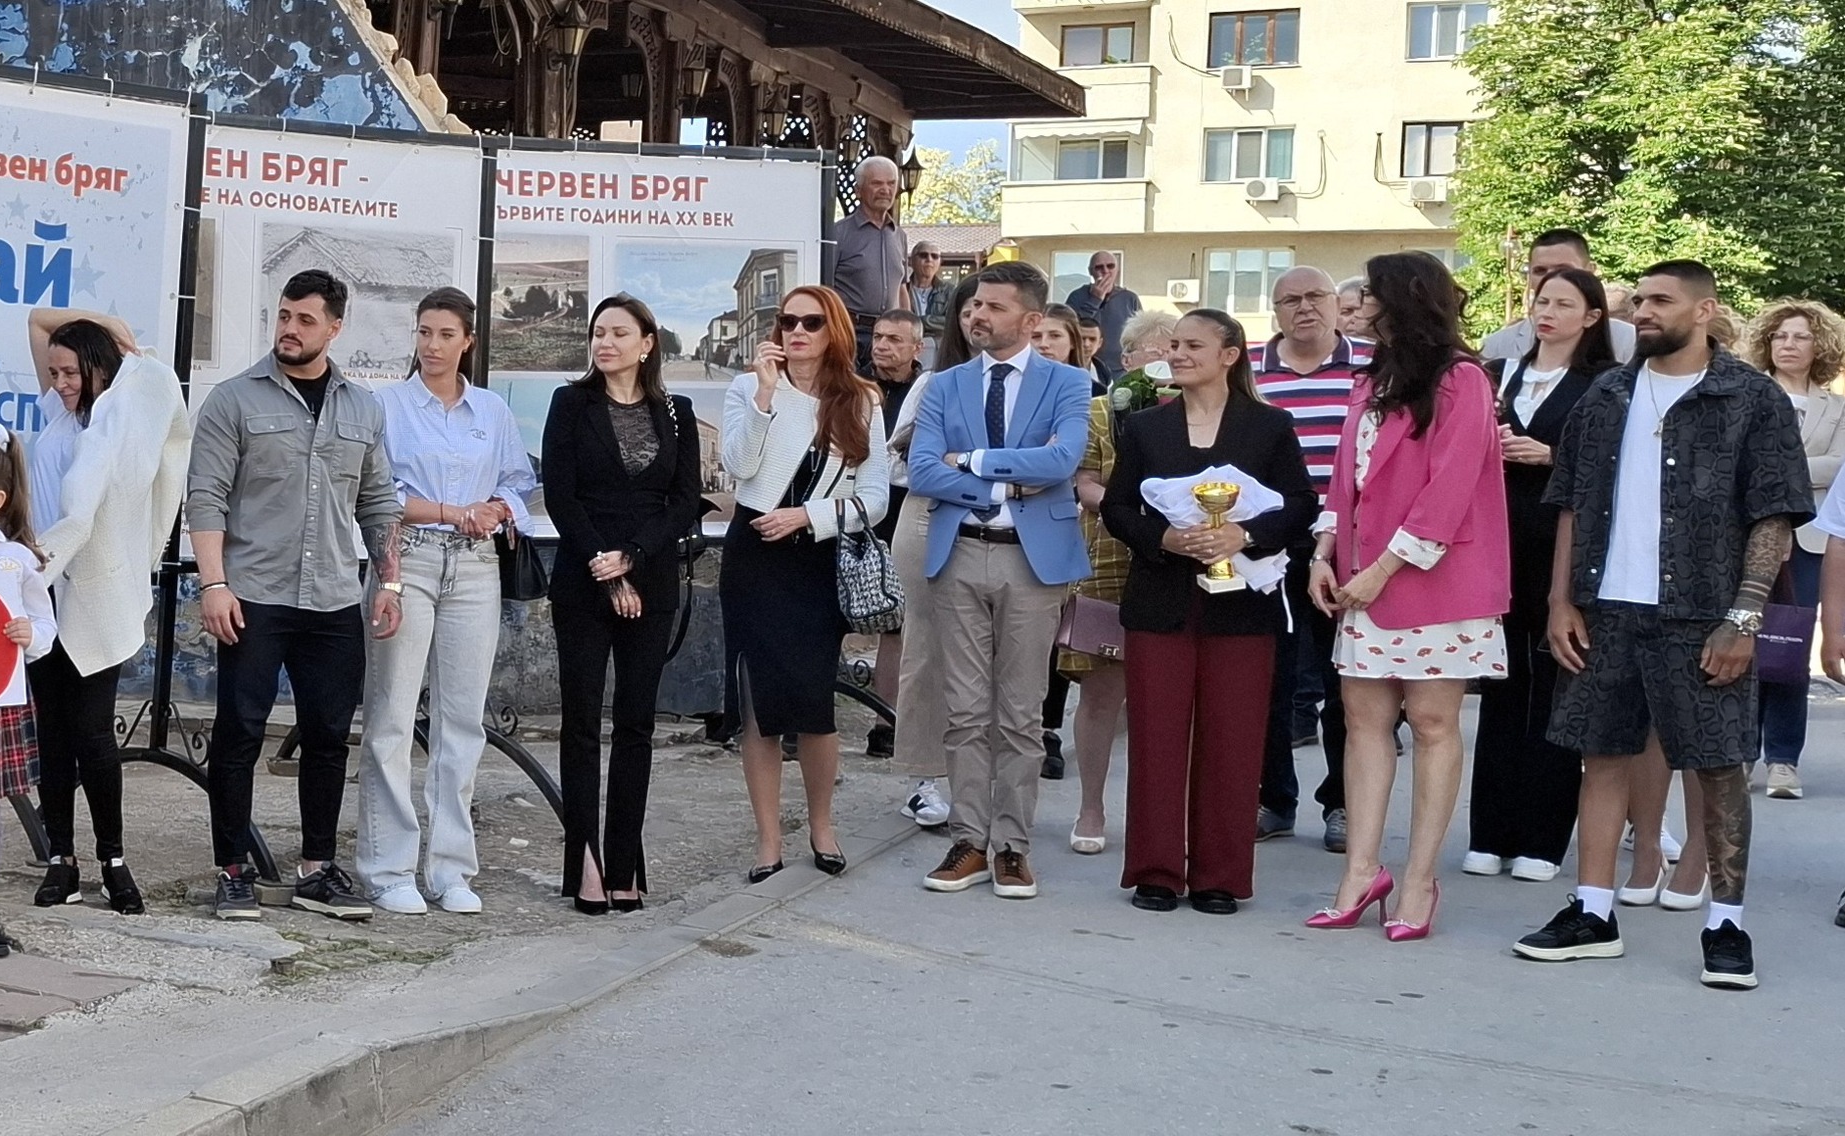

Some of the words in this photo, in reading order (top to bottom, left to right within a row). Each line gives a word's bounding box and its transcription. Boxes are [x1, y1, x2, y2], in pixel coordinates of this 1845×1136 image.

[53, 152, 129, 197] бряг
[261, 152, 348, 187] БРЯГ
[496, 169, 618, 199] ЧЕРВЕН
[631, 174, 709, 202] БРЯГ
[217, 188, 243, 206] НА
[249, 191, 398, 218] ОСНОВАТЕЛИТЕ
[570, 207, 642, 225] ГОДИНИ
[648, 210, 671, 225] НА
[702, 212, 734, 227] ВЕК
